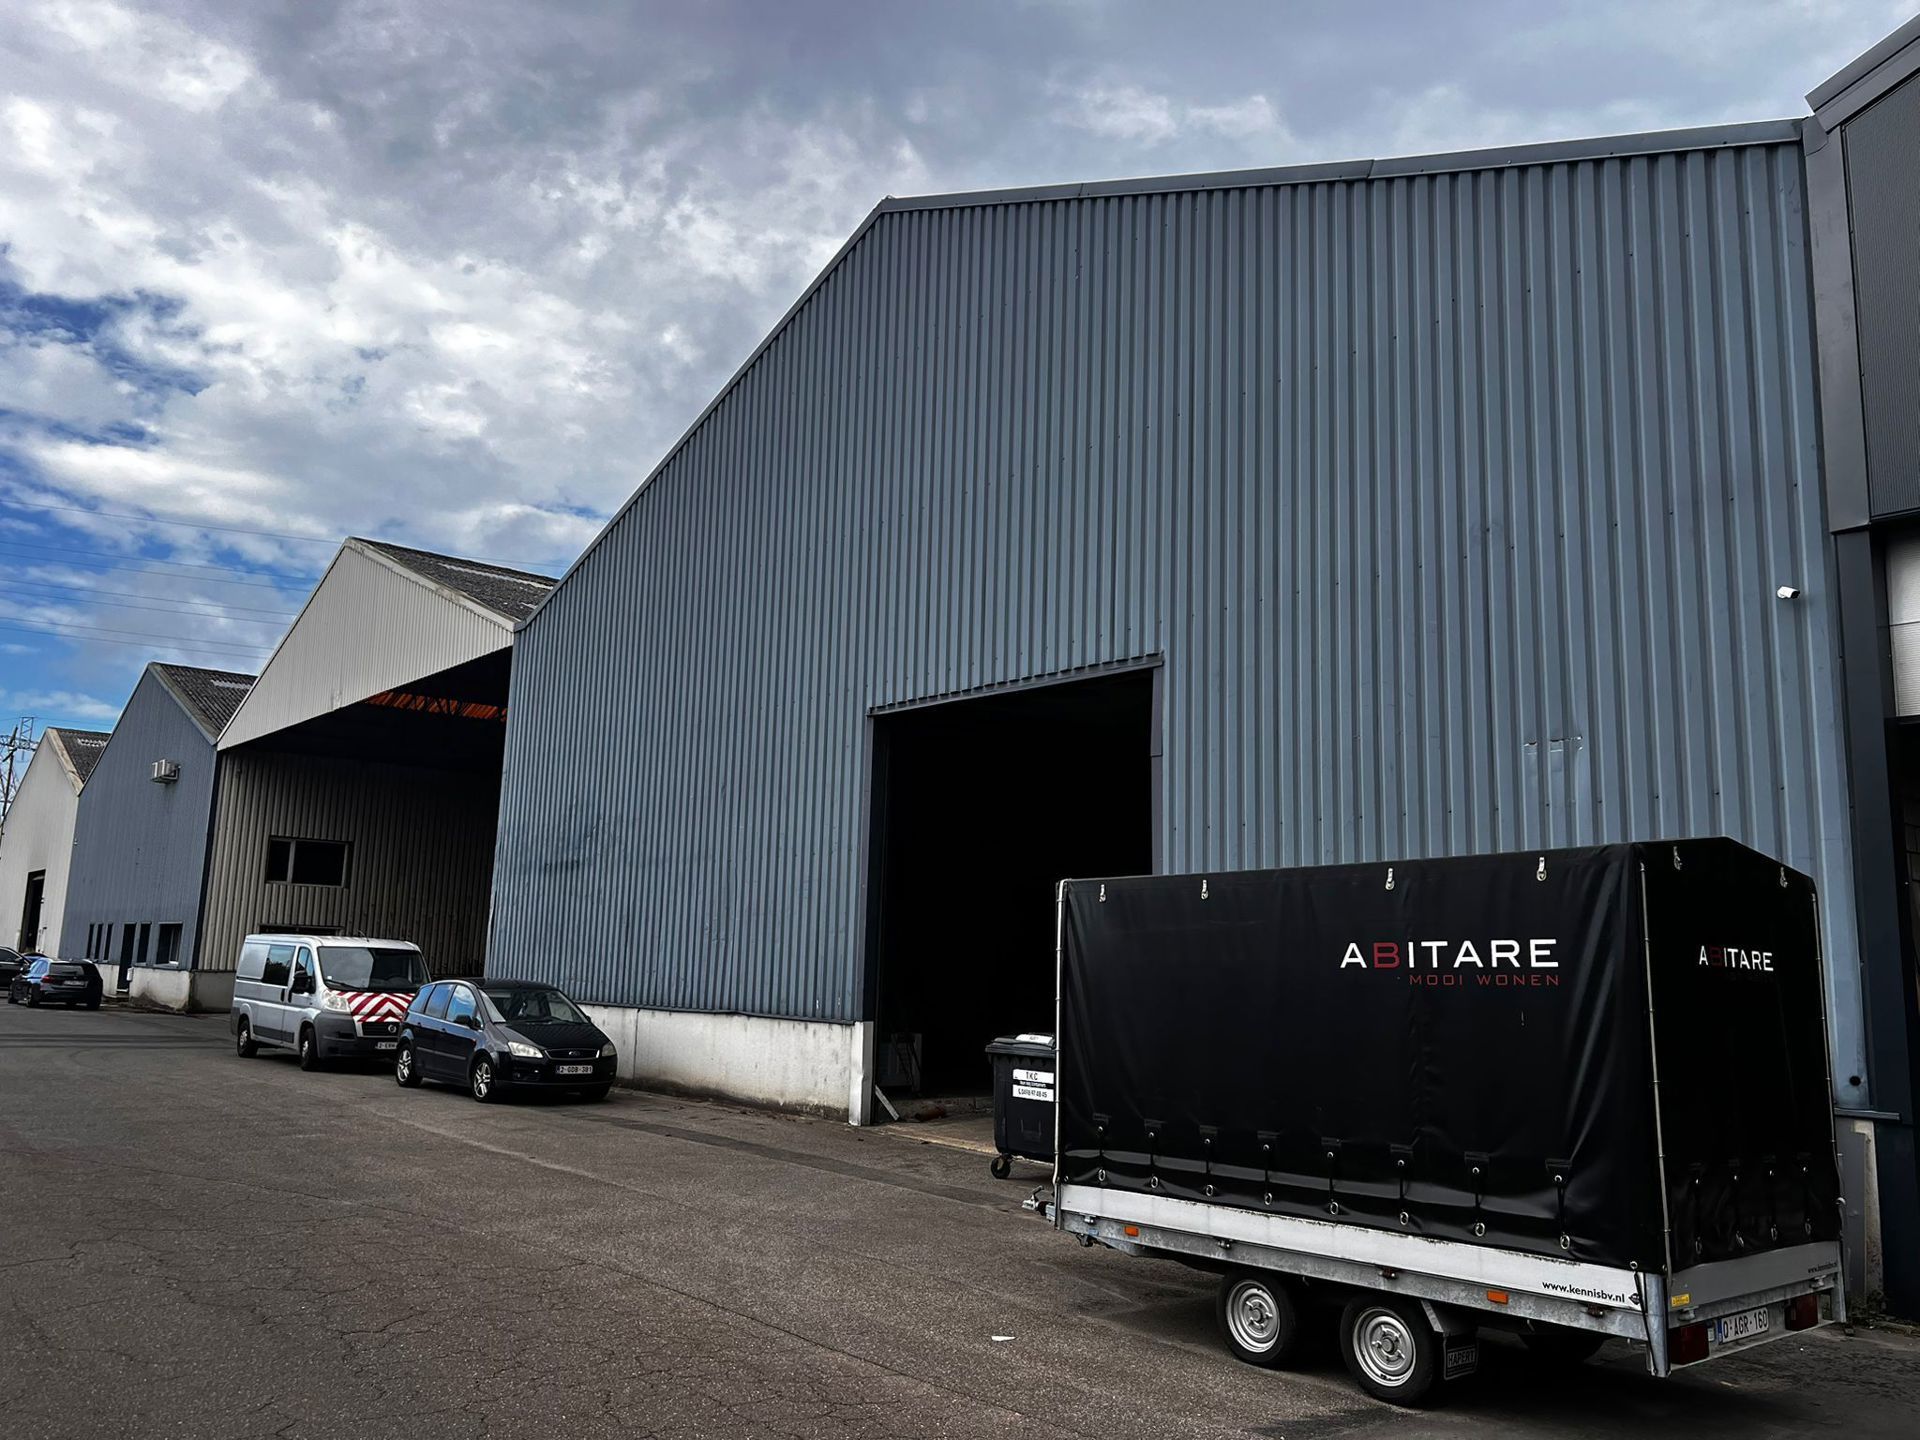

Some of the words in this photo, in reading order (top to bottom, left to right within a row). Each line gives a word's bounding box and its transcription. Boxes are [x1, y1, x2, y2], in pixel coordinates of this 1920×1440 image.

[1340, 939, 1559, 969] ABITARE
[1699, 945, 1774, 972] ABITARE
[1409, 974, 1464, 986] MOOI
[1476, 974, 1559, 986] WONEN
[1542, 1281, 1625, 1303] www.kennisbv.nl
